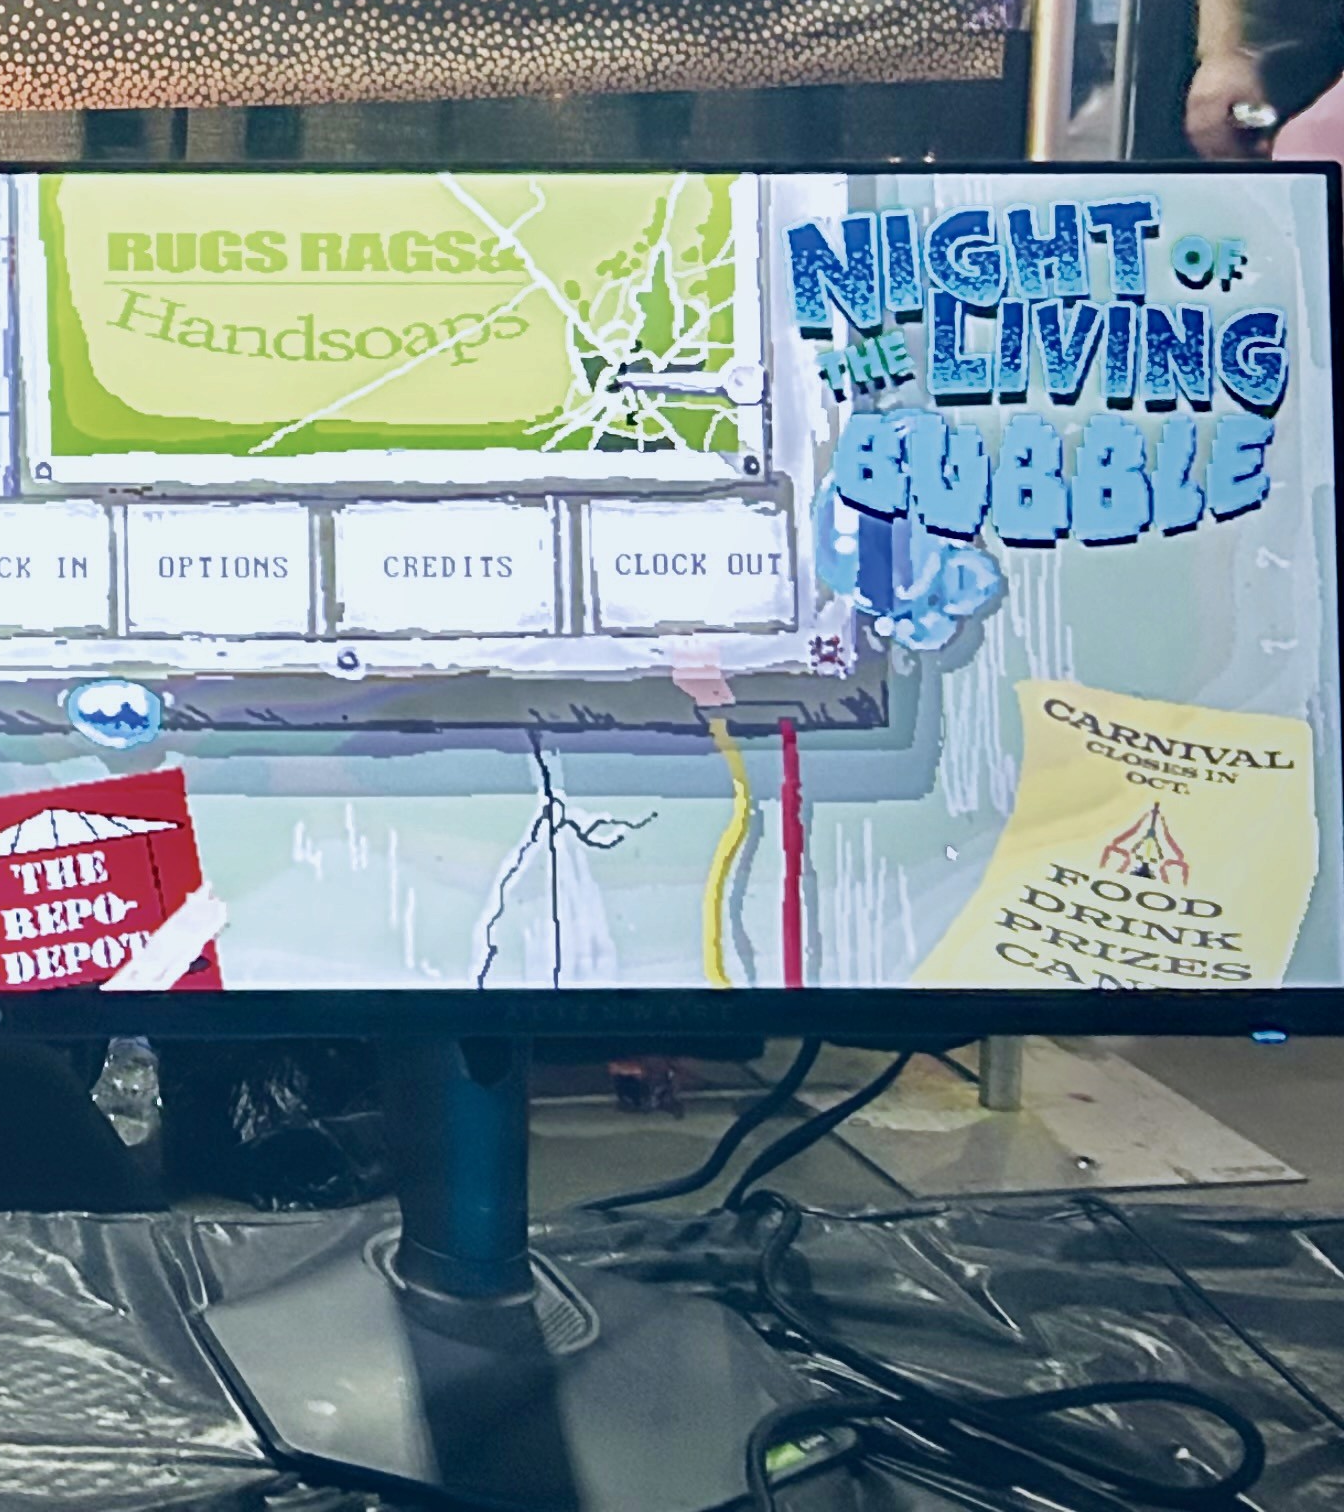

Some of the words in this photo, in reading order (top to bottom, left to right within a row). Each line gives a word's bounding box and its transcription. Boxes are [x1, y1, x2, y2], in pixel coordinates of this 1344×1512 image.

[107, 230, 288, 274] RUGS
[782, 196, 1160, 339] NIGHT
[1171, 235, 1248, 291] OF
[106, 288, 531, 367] Handsoaps
[817, 330, 915, 402] THE
[927, 287, 1289, 418] LIVING
[833, 408, 1276, 548] BUBBLE
[57, 554, 89, 579] IN
[158, 553, 289, 580] OPTIONS
[383, 553, 513, 579] CREDITS
[615, 551, 708, 578] CLOCK
[728, 551, 783, 577] OUT
[1043, 698, 1295, 770] CARNIVAL
[1086, 740, 1198, 779] CLOSES
[1205, 769, 1239, 785] IN
[1125, 770, 1191, 796] OCT.
[9, 850, 109, 895] THE
[1045, 862, 1223, 919] FOOD
[995, 907, 1253, 983] PRIZES
[1019, 884, 1243, 953] DRINK
[0, 931, 150, 984] DEPOT
